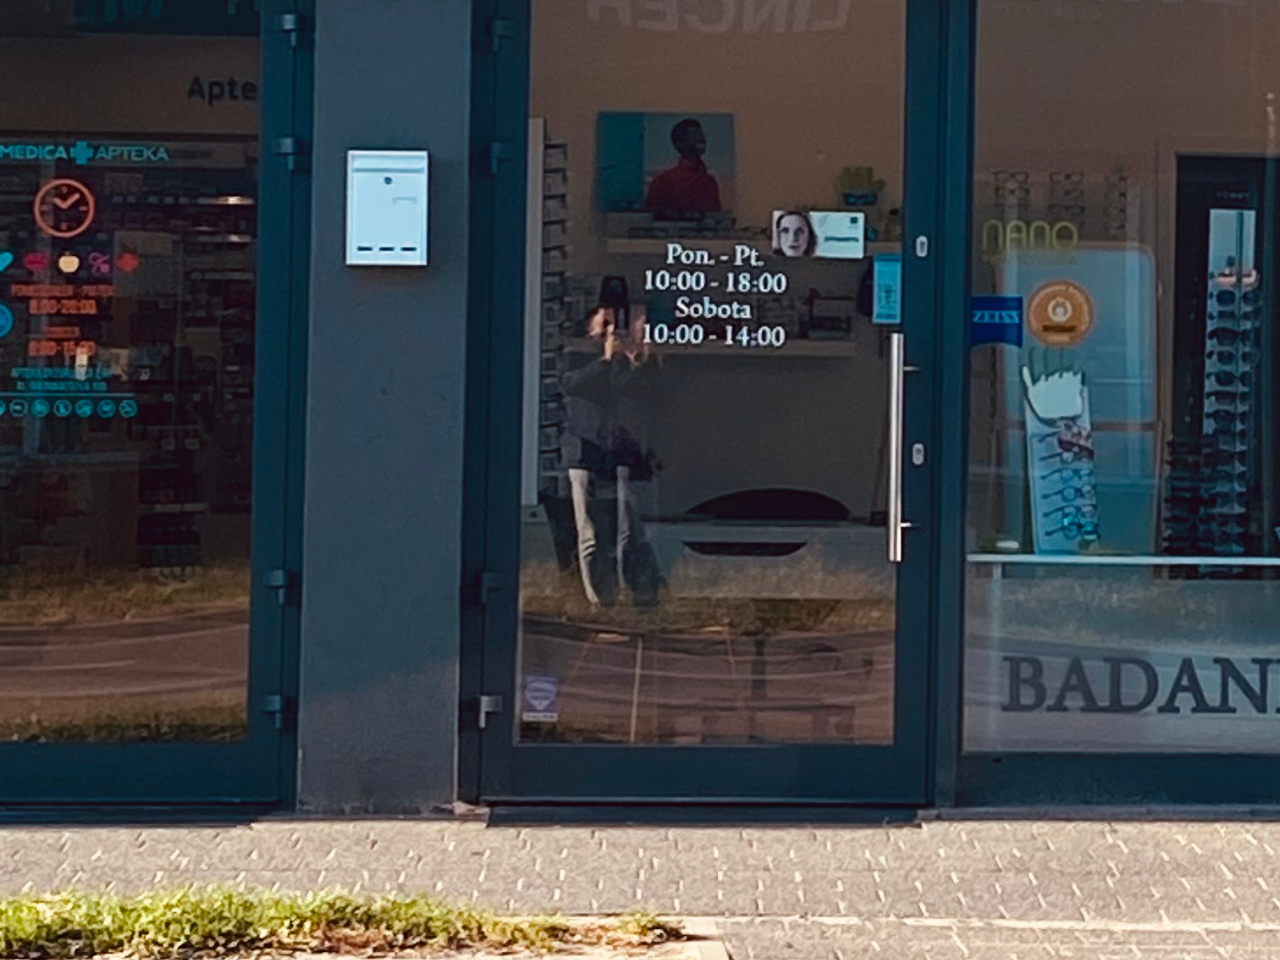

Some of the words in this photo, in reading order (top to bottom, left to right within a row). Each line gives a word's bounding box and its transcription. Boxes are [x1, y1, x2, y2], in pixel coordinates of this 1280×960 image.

[187, 75, 258, 106] Apte
[0, 145, 68, 160] MEDICA
[95, 146, 169, 161] APTEKA
[666, 243, 716, 265] Pon.
[733, 245, 764, 266] Pt.
[645, 270, 706, 291] 10:00
[726, 272, 787, 293] 18:00
[675, 296, 752, 319] Sobota
[972, 310, 1020, 324] ZEISS
[643, 323, 704, 343] 10:00
[724, 325, 786, 347] 14:00
